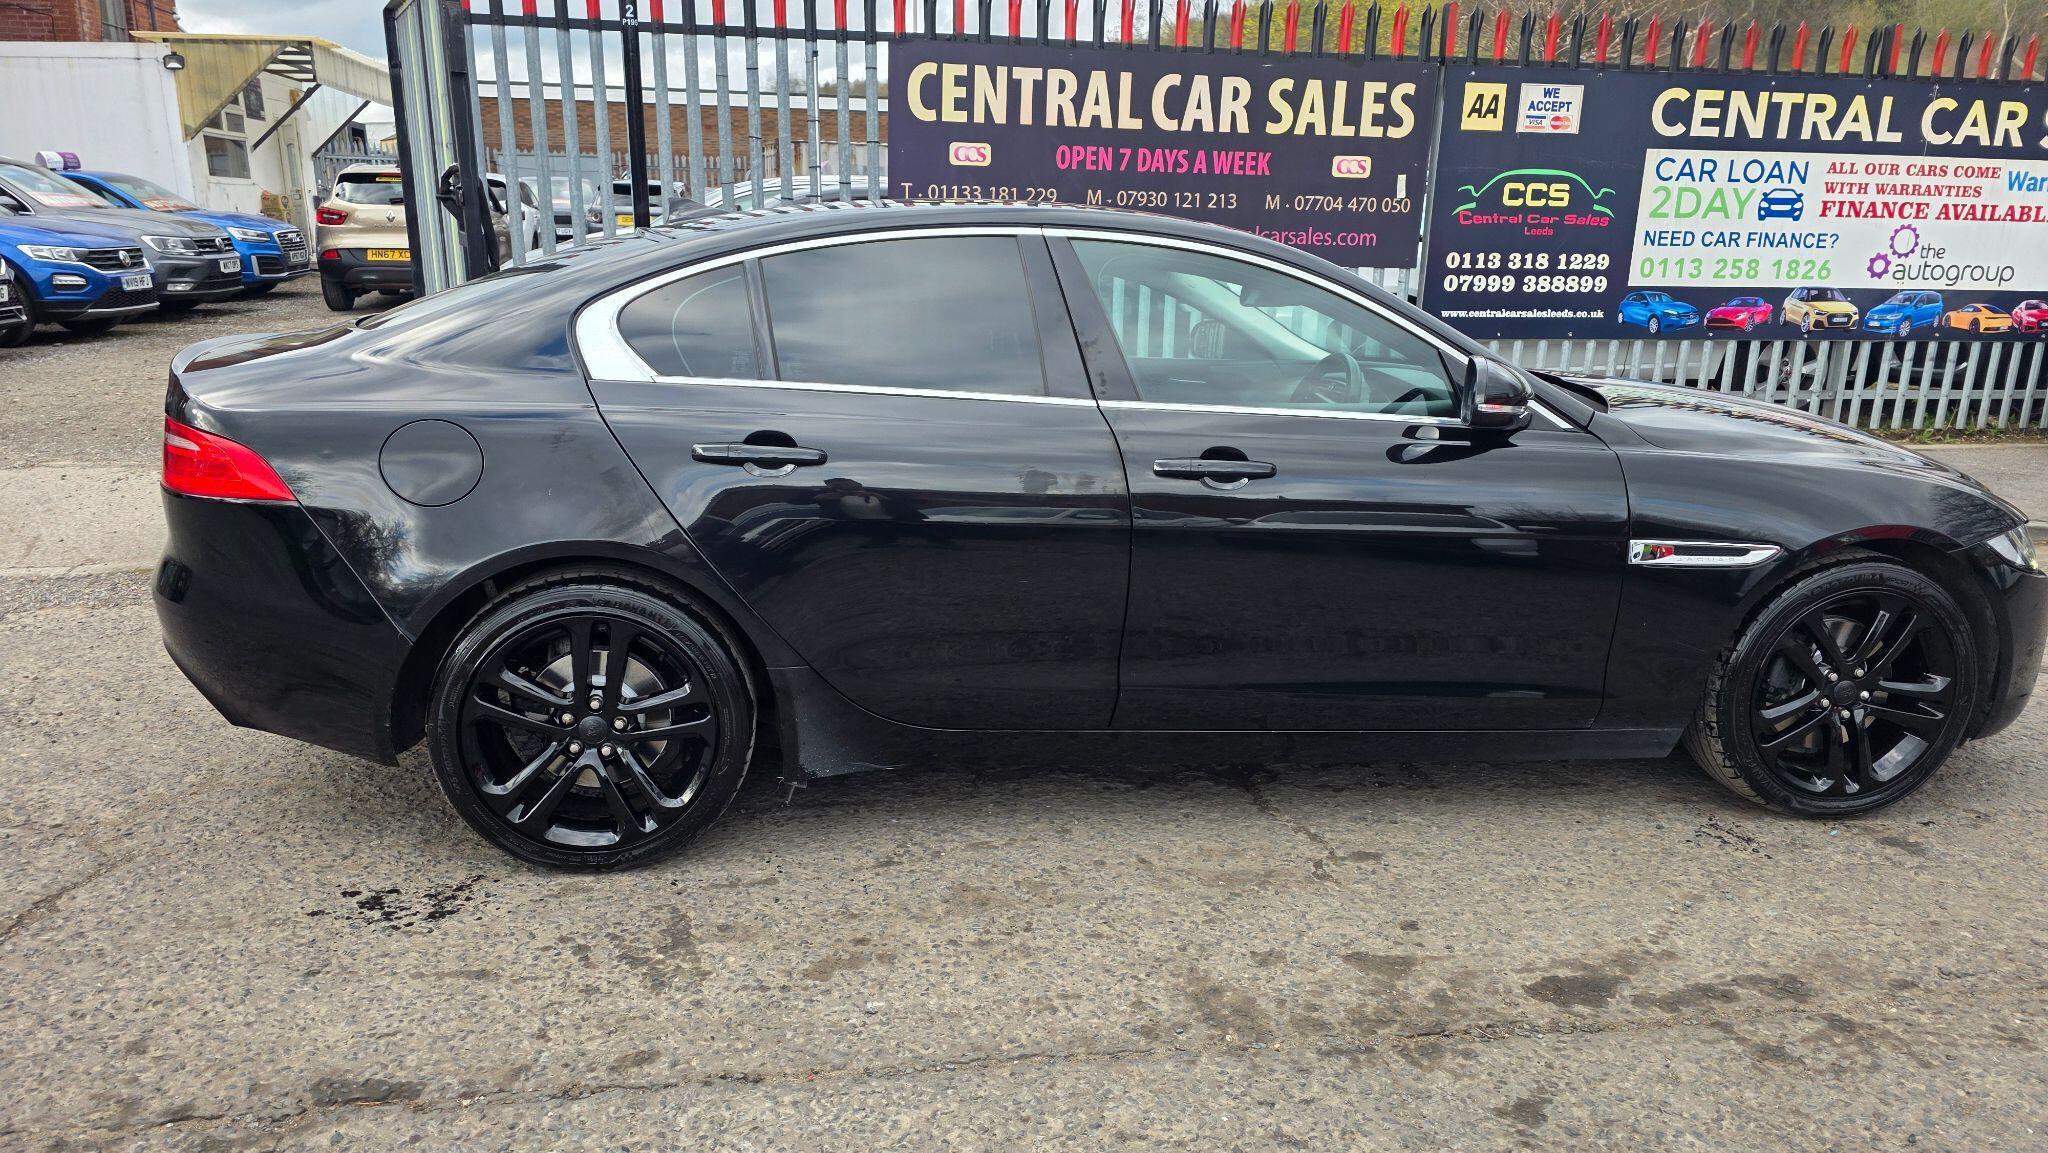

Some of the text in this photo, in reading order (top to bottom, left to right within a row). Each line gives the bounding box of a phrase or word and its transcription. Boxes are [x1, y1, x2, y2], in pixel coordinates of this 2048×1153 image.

[625, 4, 634, 18] 2
[907, 62, 1417, 139] CENTRAL CAR SALES
[1543, 87, 1561, 99] WE
[1467, 93, 1500, 119] AA
[1528, 100, 1572, 112] ACCEPT
[1651, 87, 1903, 143] CENTRAL
[1921, 97, 2029, 147] CAR
[1055, 144, 1272, 176] OPEN 7 DAYS A WEEK
[1655, 156, 1810, 185] CAR LOAN
[1826, 162, 2002, 179] ALL OUR CARS COME
[901, 182, 1058, 203] T 01133 181 229
[1086, 189, 1237, 209] M 07930 121 213
[1502, 182, 1570, 207] CCS
[1824, 182, 1983, 198] WITH WARRANTIES
[1265, 194, 1411, 214] M 07704 470 050
[1649, 185, 1757, 220] 2DAY
[1819, 200, 2048, 223] FINANCE AVAILABL
[1458, 210, 1610, 227] Central Car Sales
[1524, 227, 1554, 236] Leeds
[1643, 230, 1840, 249] NEED CAR FINANCE?
[371, 249, 395, 259] HN67
[1446, 251, 1610, 270] 0113 318 1229
[1920, 243, 1946, 260] the
[1640, 257, 1832, 280] 0113 258 1826
[1892, 261, 2015, 287] autogroup
[1443, 274, 1608, 293] 07999 388899
[1441, 308, 1604, 319] www.centralcarsalesleeds.co.uk
